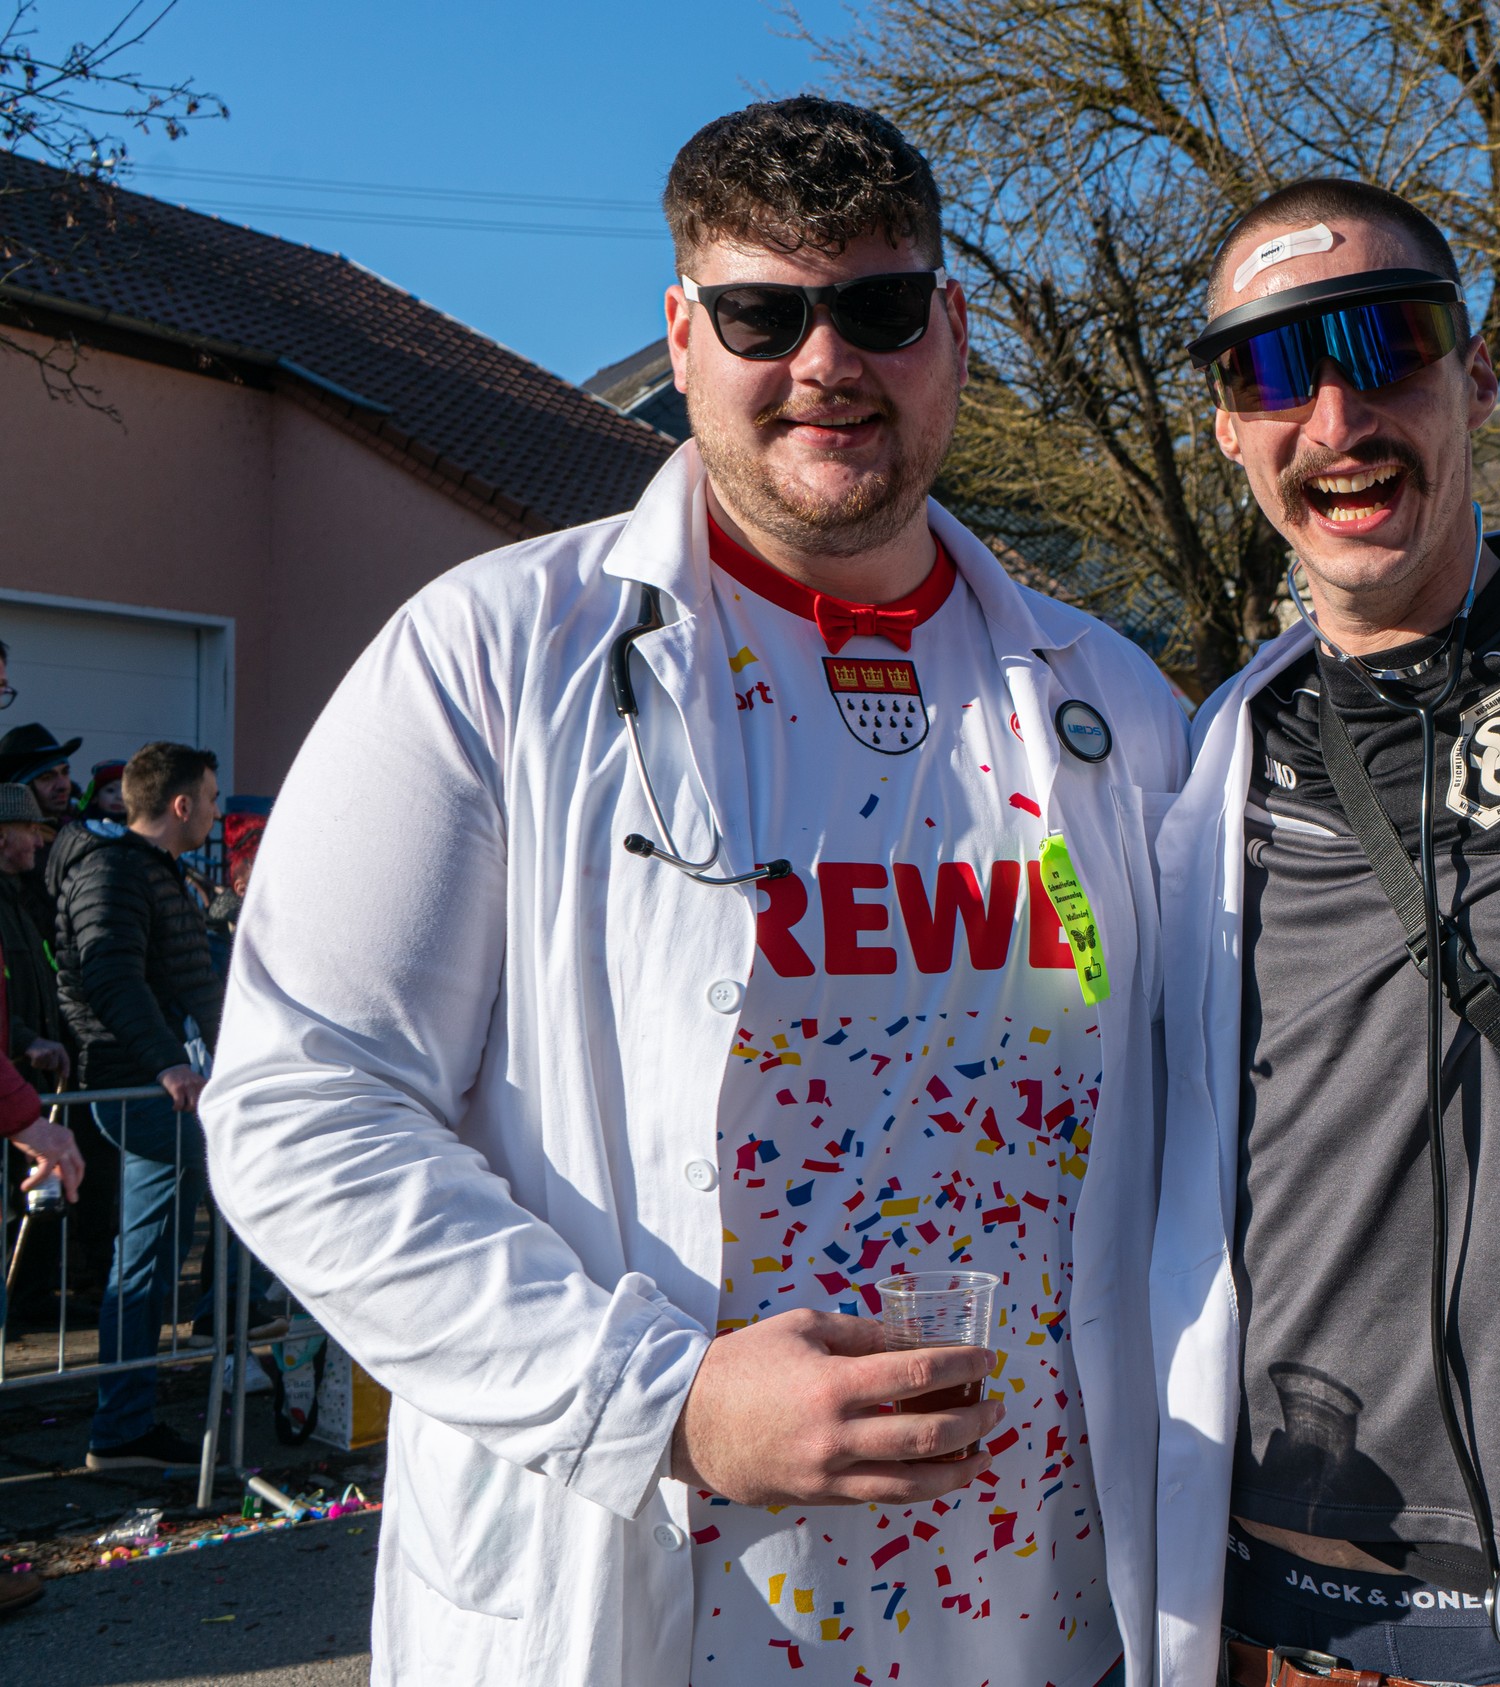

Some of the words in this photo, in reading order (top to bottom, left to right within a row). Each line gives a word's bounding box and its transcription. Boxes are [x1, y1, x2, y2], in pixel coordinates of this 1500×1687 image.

[1285, 1569, 1363, 1605] JACK
[1367, 1588, 1389, 1607] &
[1395, 1590, 1483, 1610] JONE
